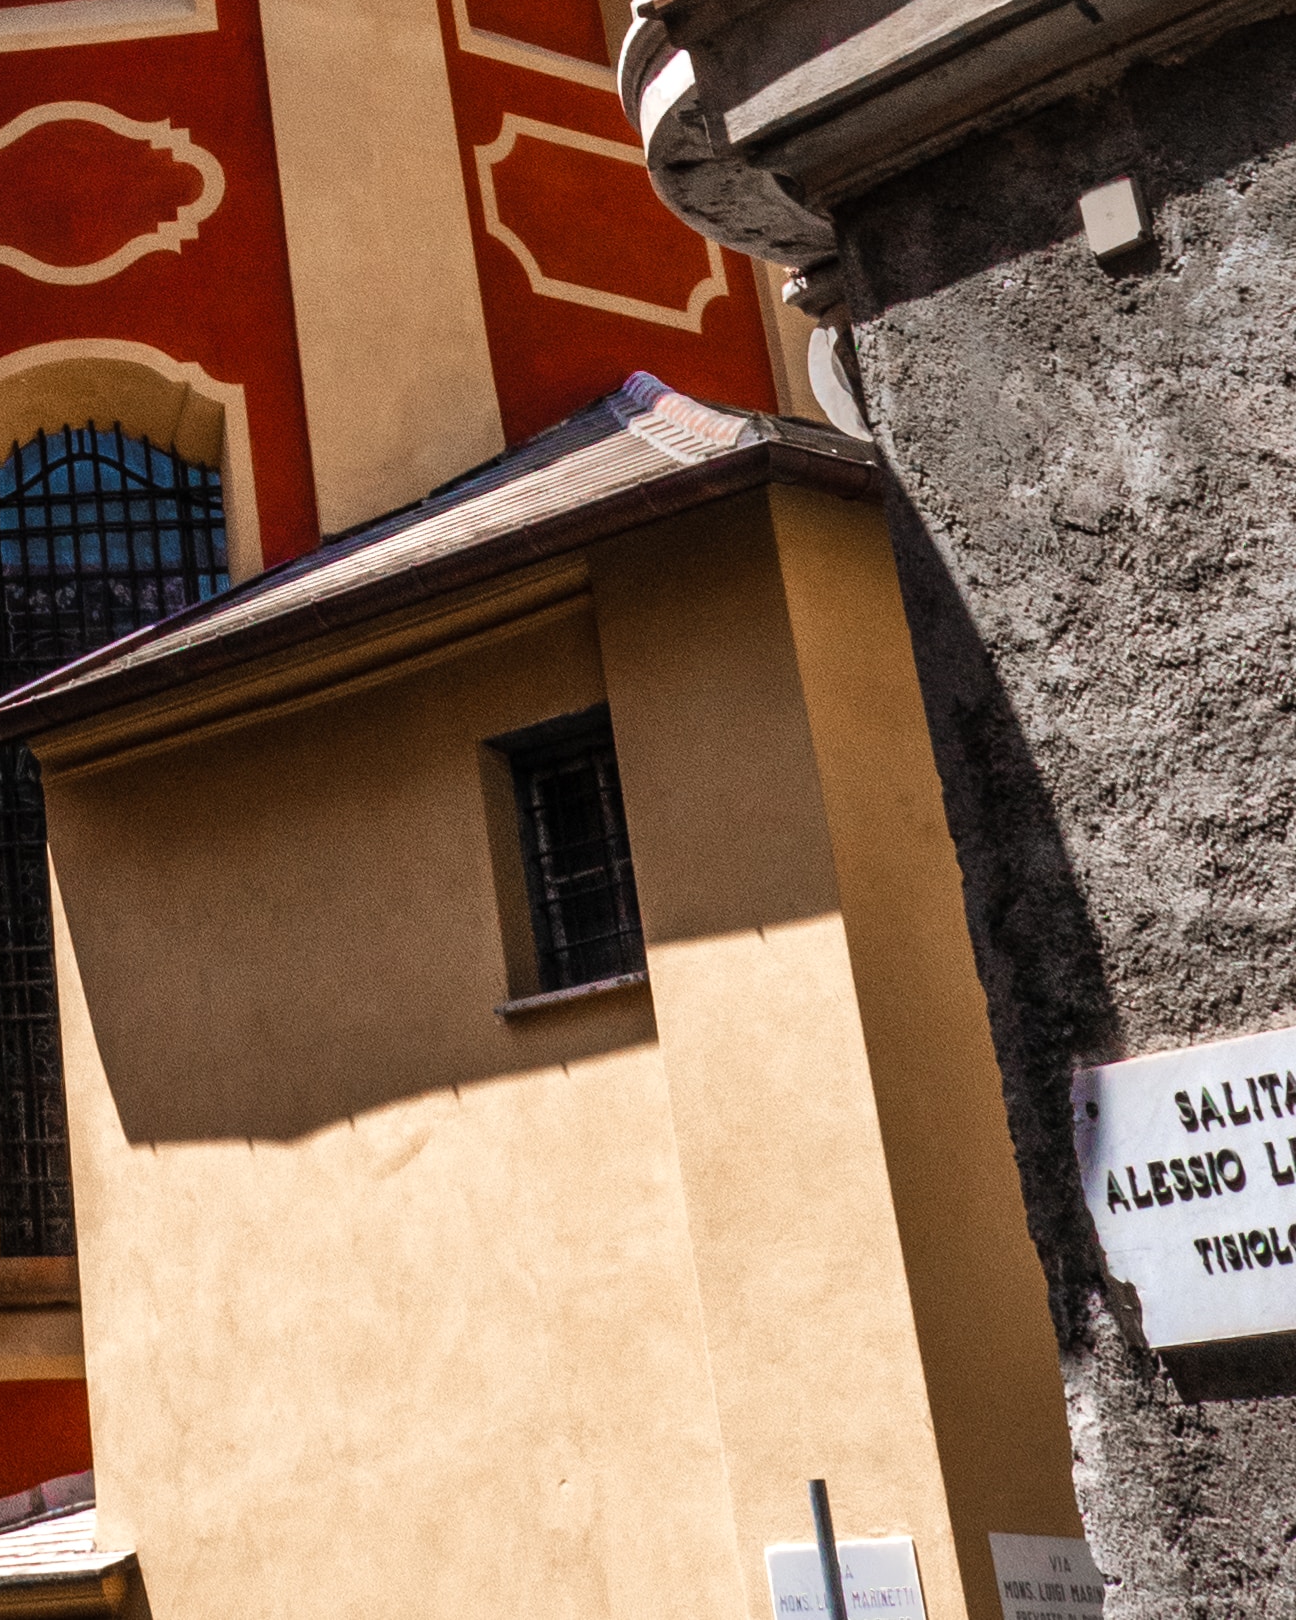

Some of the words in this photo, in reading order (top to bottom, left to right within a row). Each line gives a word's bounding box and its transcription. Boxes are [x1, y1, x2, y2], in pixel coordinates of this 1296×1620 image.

[1107, 1147, 1246, 1215] ALESSIO
[1048, 1554, 1073, 1573] VIA
[851, 1587, 916, 1610] MARINETTI
[1037, 1582, 1066, 1603] LUIGI
